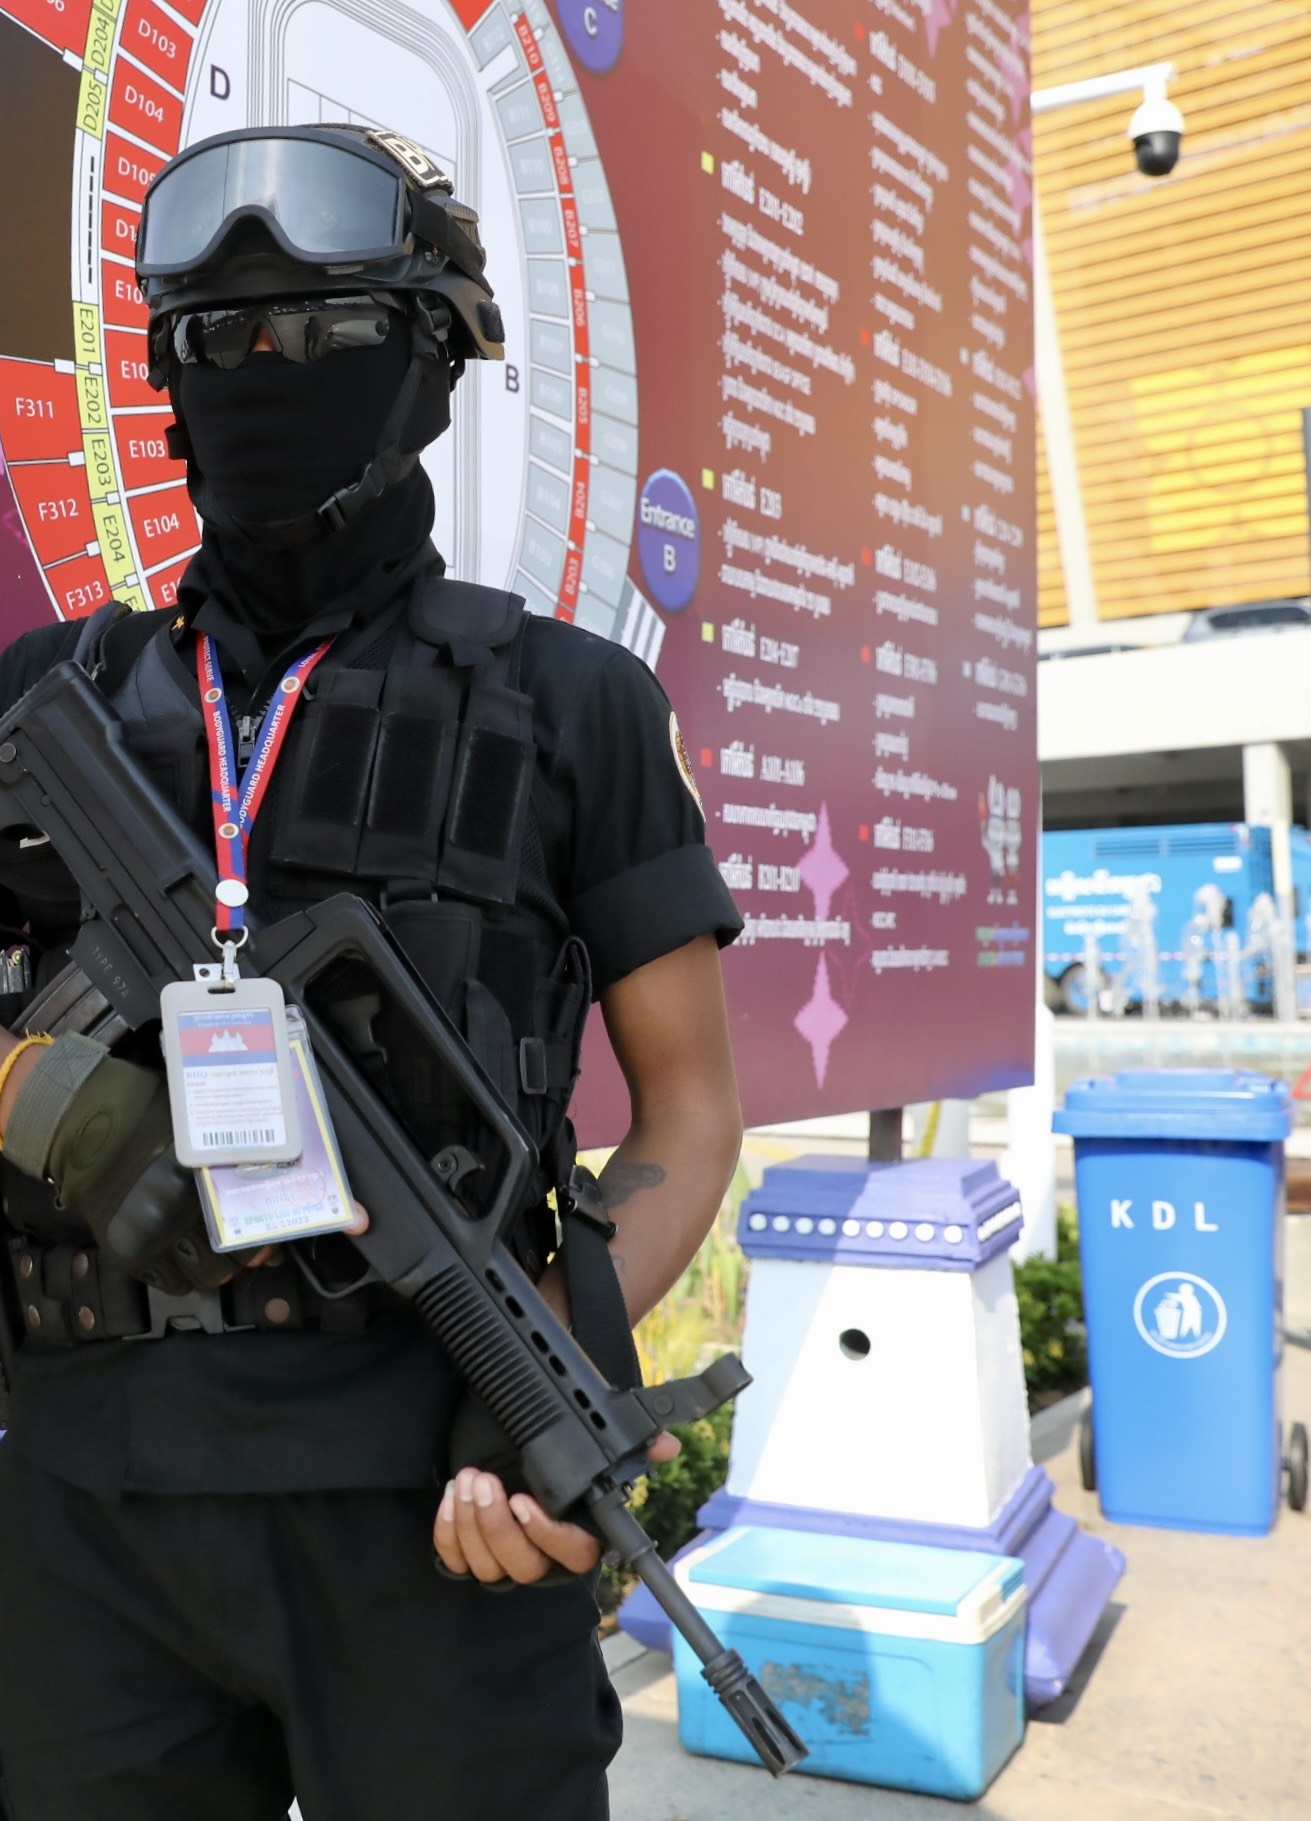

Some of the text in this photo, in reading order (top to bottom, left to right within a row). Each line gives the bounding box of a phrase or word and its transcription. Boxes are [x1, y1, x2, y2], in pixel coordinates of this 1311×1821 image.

[137, 18, 176, 58] D103
[584, 6, 598, 35] C
[91, 17, 111, 67] D204
[210, 64, 231, 101] D
[83, 77, 103, 132] D205
[124, 84, 164, 123] D104
[78, 307, 96, 354] E201
[504, 364, 520, 393] B
[15, 397, 55, 419] F311
[83, 376, 102, 424] E202
[92, 438, 112, 487] E203
[129, 440, 166, 458] E103
[38, 499, 79, 522] F312
[143, 513, 181, 539] E104
[640, 497, 696, 539] Entrance
[103, 514, 126, 563] E204
[662, 544, 677, 573] B
[65, 581, 104, 611] F313
[254, 704, 287, 773] HEADQUARTER
[213, 710, 232, 812] BODYGUARD HEADQUARTER
